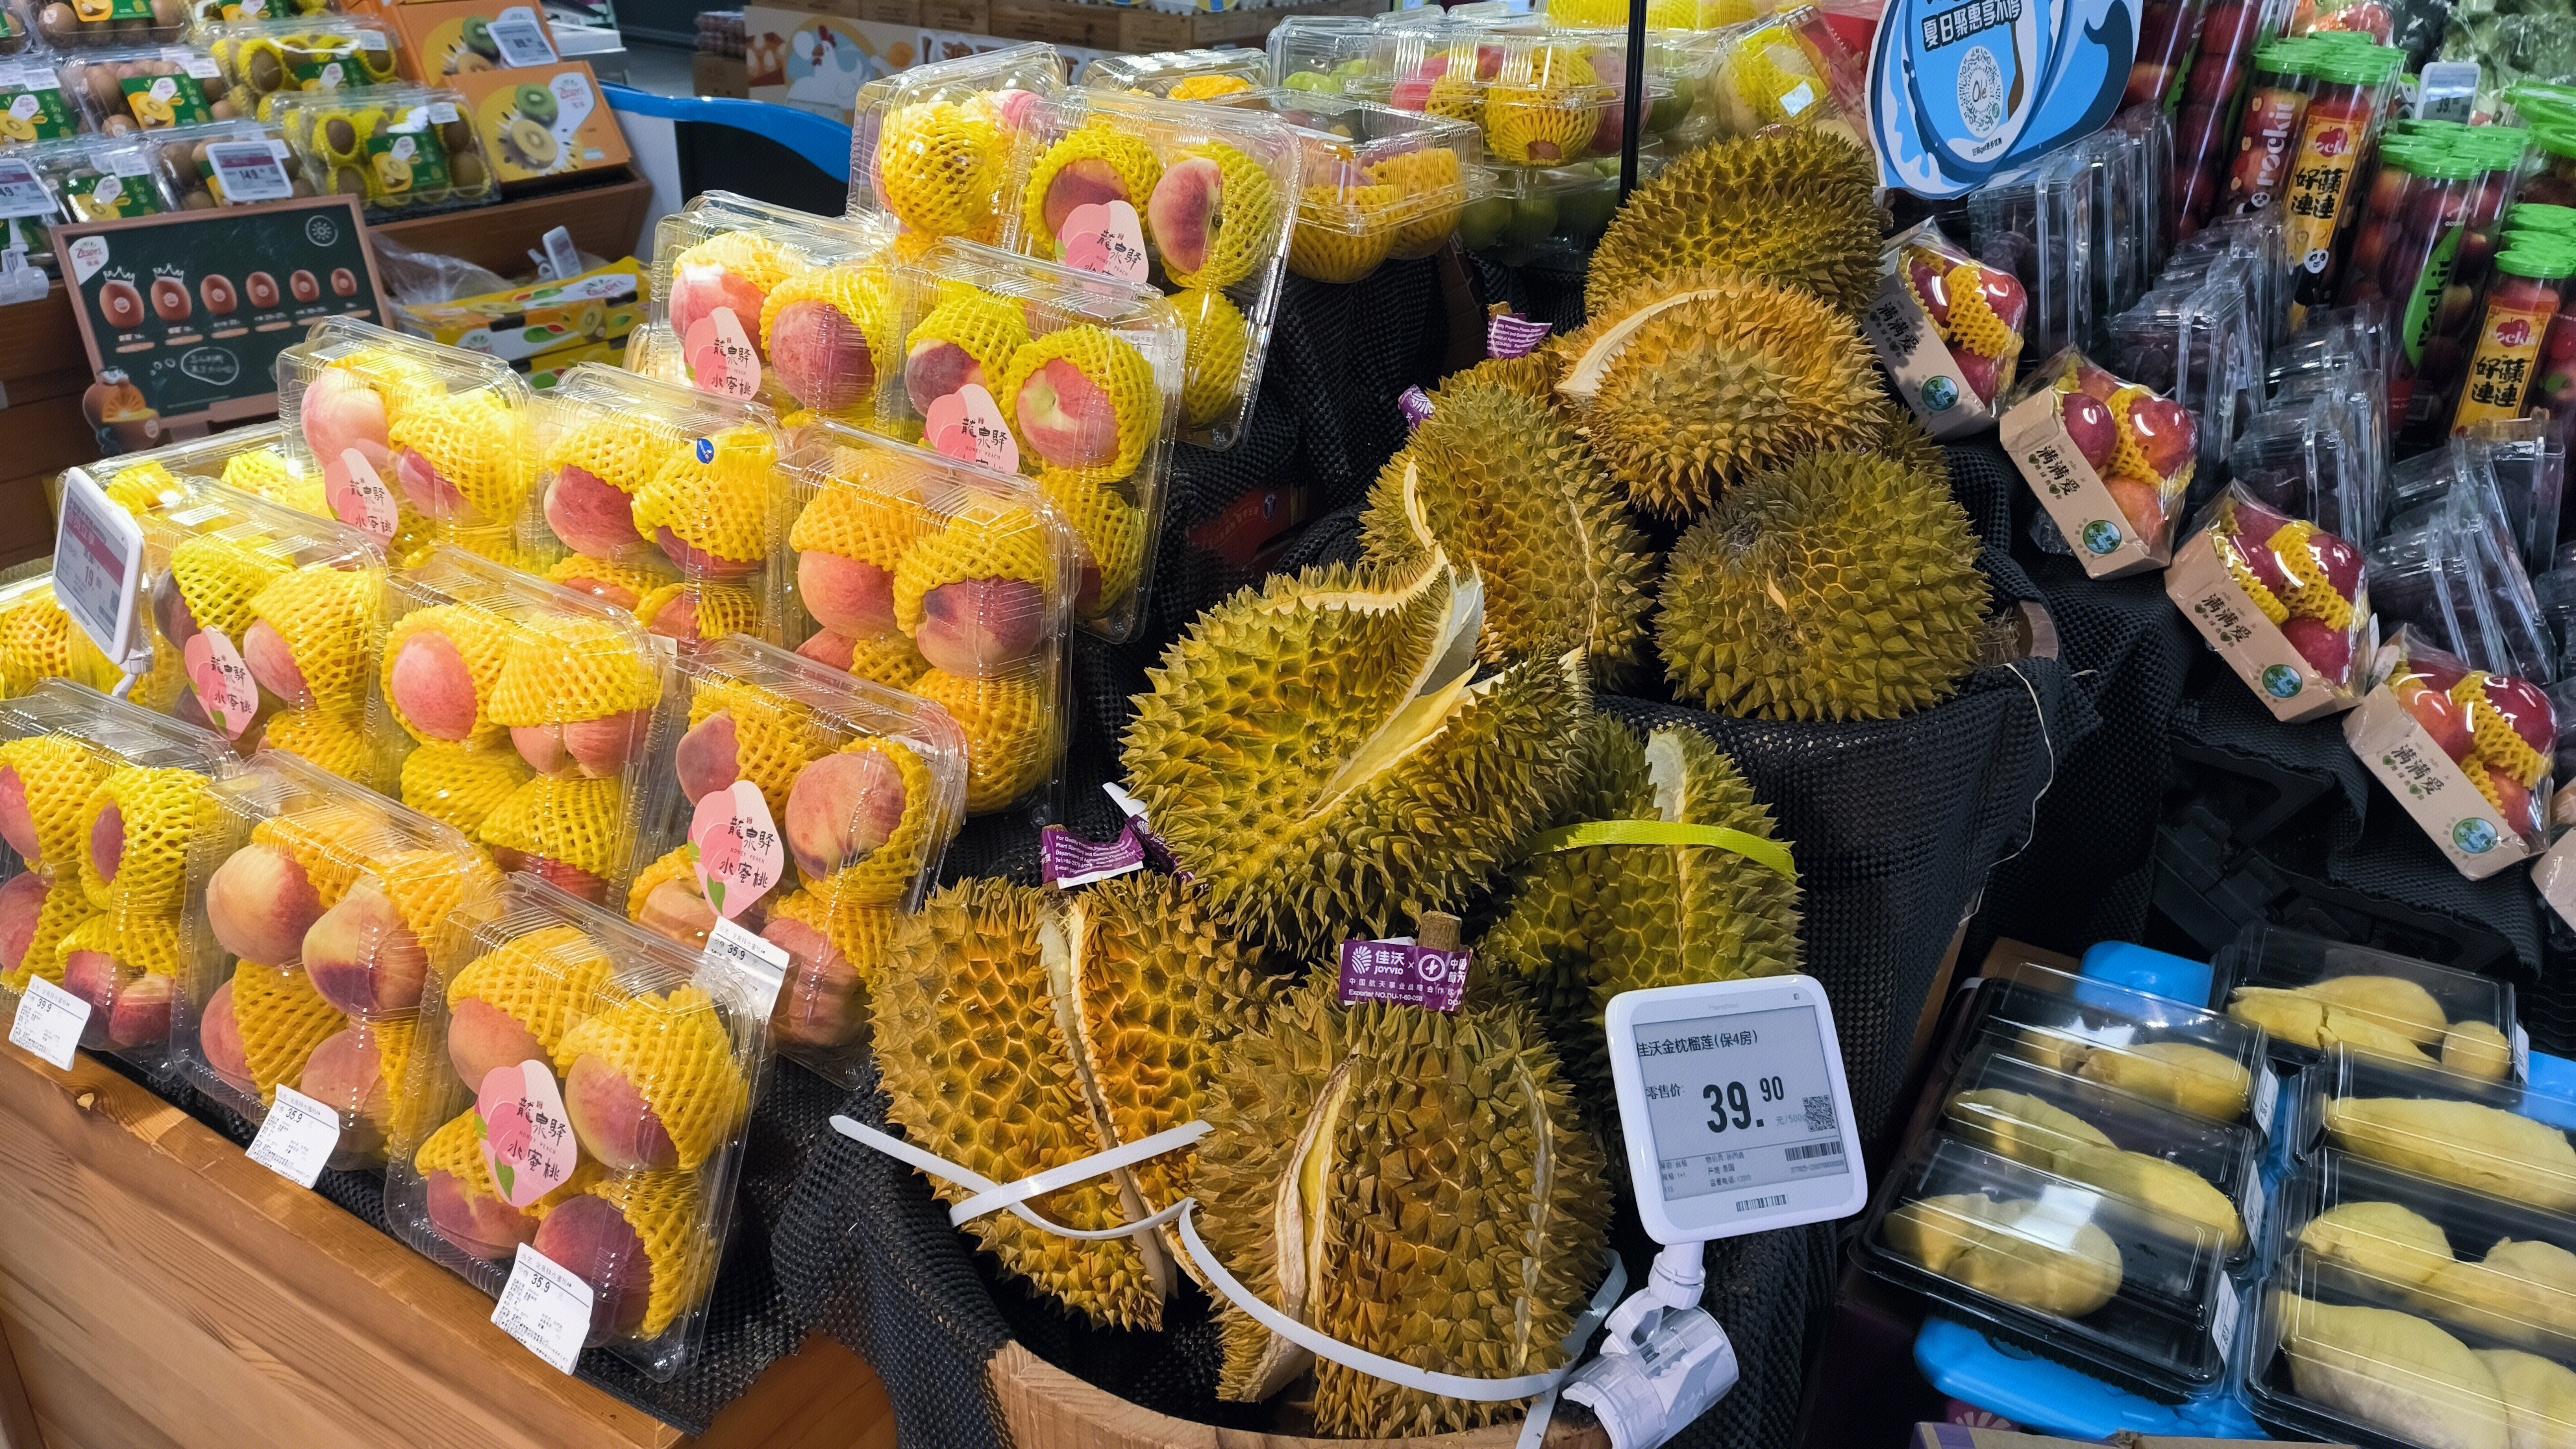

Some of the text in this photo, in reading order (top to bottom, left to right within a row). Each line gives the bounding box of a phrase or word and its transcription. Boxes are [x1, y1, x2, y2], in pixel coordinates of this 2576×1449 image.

[750, 854, 765, 864] PEACH
[719, 856, 768, 888] 水蜜桃
[1374, 950, 1405, 967] 佳沃
[508, 1140, 560, 1182] 水蜜桃
[531, 1274, 551, 1293] 35.9
